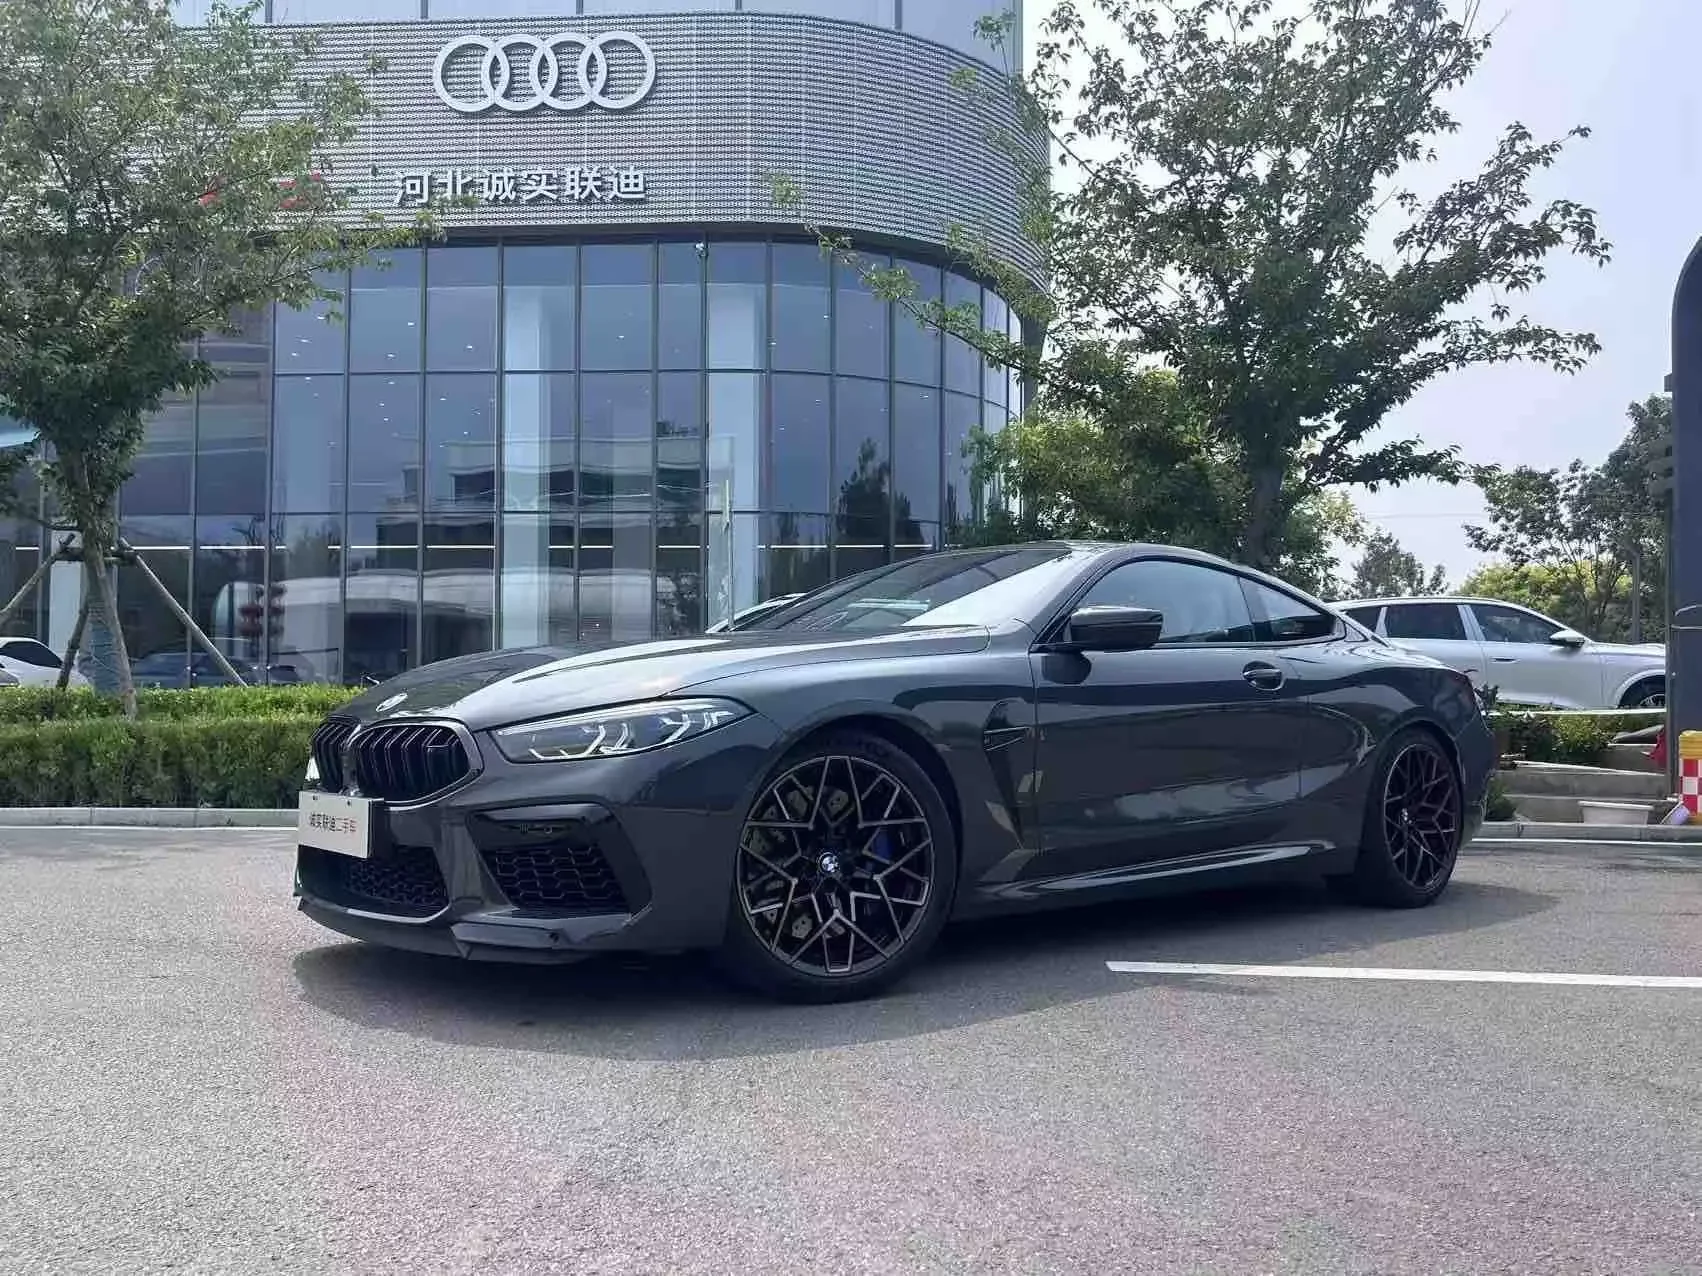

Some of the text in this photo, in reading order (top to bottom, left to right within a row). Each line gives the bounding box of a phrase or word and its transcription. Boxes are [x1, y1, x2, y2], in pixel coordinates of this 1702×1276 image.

[394, 166, 646, 204] 河北诚实联迪
